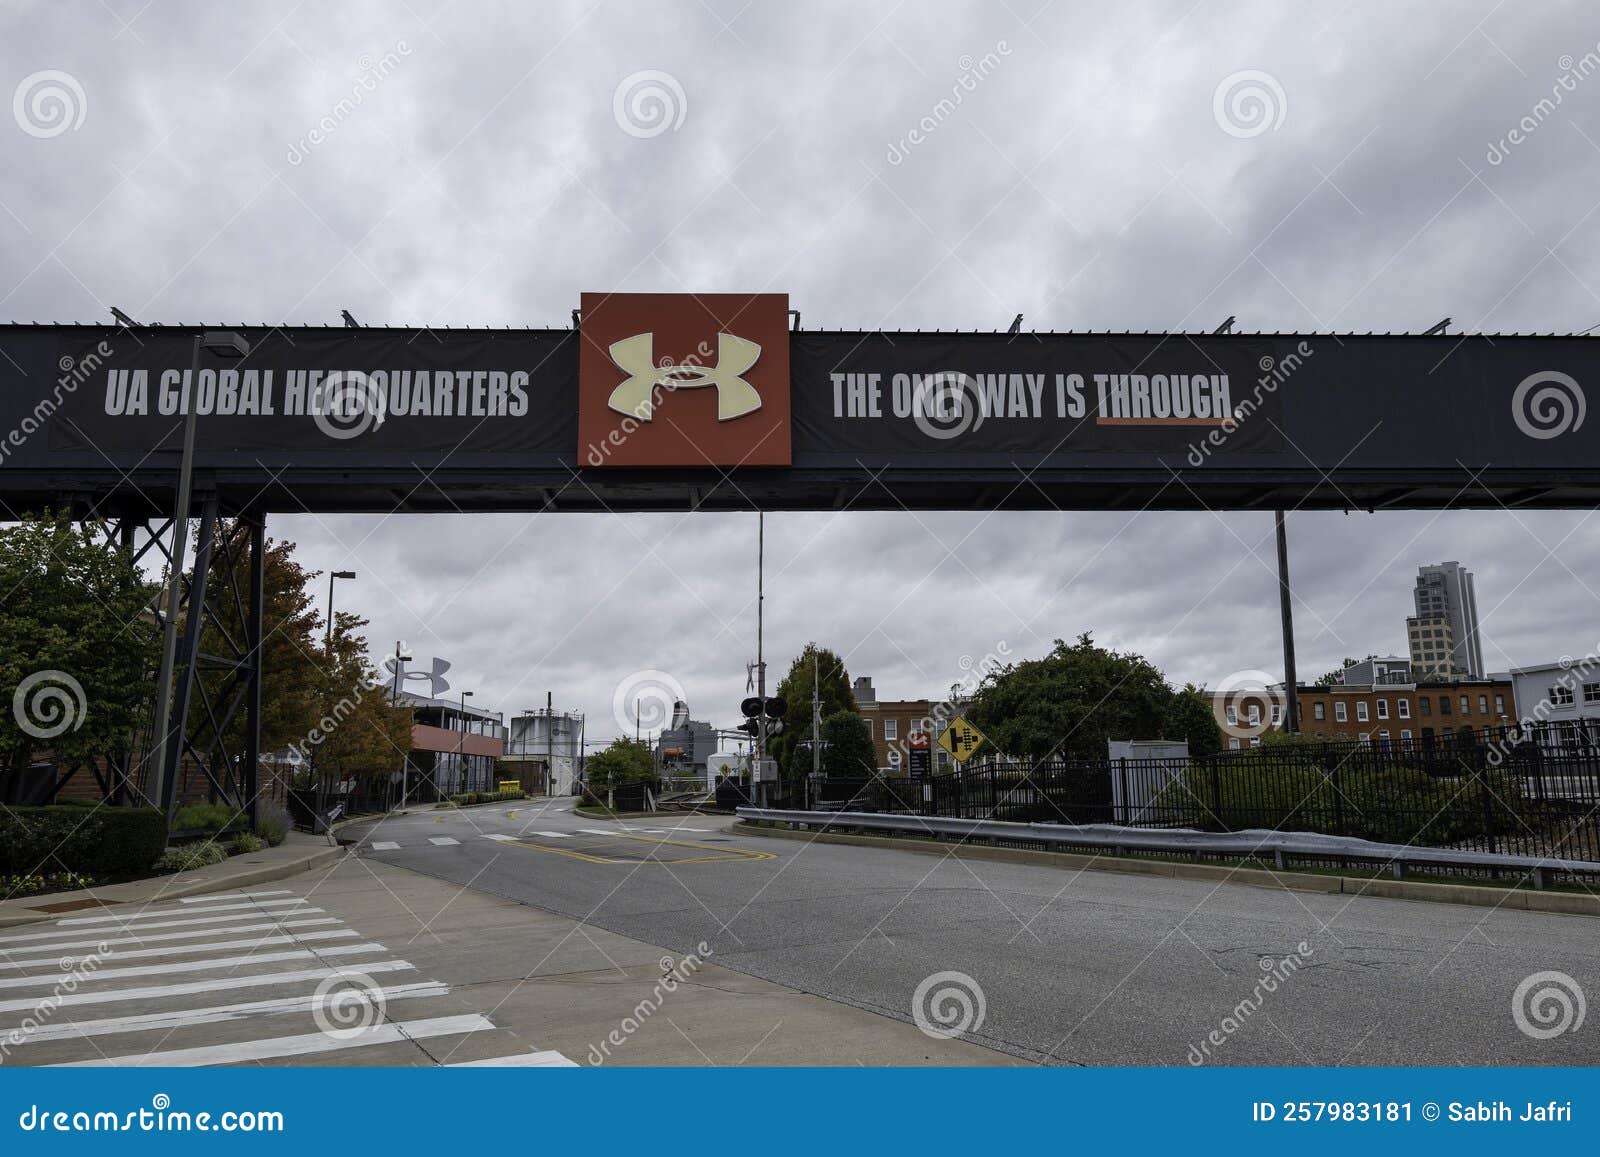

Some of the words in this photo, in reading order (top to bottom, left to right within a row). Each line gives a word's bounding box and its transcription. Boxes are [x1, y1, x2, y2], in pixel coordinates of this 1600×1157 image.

[104, 369, 148, 416] UA
[158, 369, 274, 416] GLOBAL
[284, 369, 529, 423] HEADQUARTERS
[830, 373, 882, 418] THE
[892, 373, 967, 418] ONLY
[976, 373, 1045, 418] WAY
[1055, 373, 1086, 418] IS
[1093, 374, 1232, 419] THROUGH
